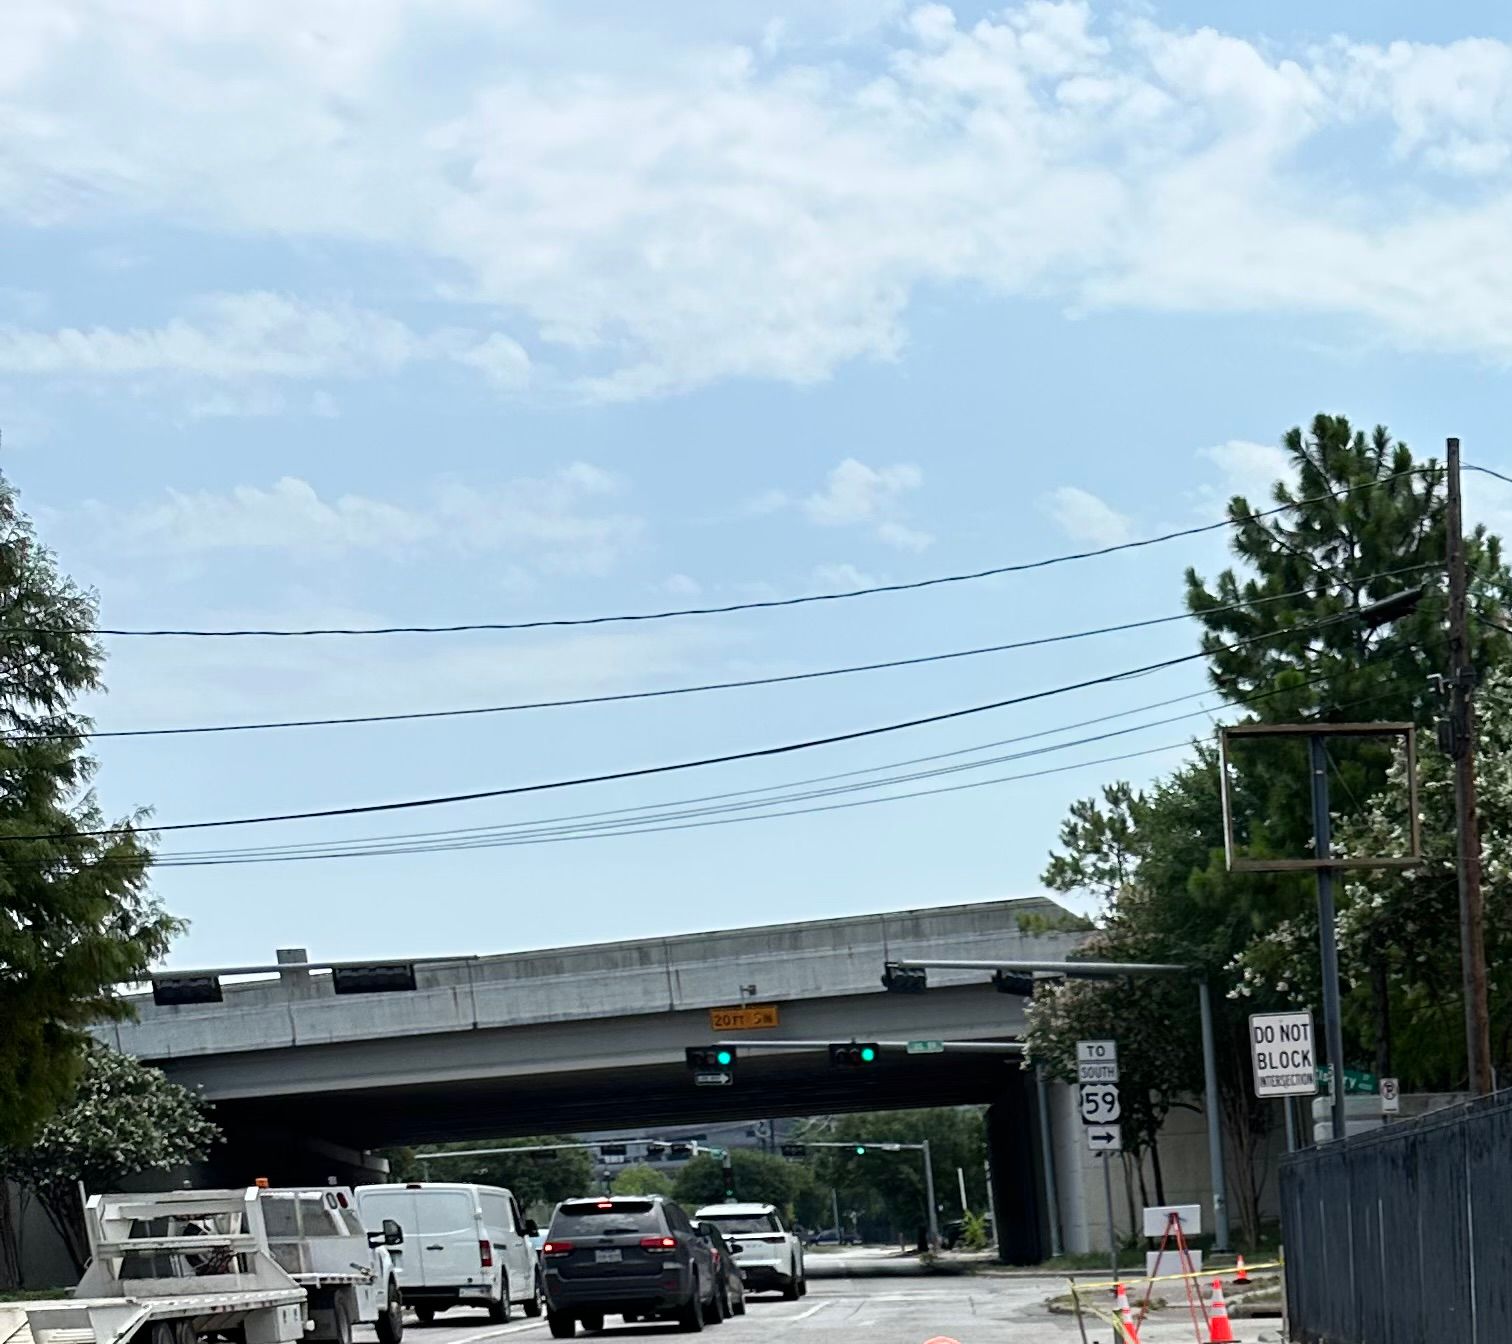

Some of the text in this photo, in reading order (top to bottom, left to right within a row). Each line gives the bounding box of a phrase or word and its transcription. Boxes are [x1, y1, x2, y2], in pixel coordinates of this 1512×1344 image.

[1254, 1024, 1309, 1044] DO NOT
[1086, 1045, 1106, 1057] TO
[1258, 1050, 1312, 1070] BLOCK
[1081, 1067, 1115, 1079] SOUTH
[1086, 1092, 1115, 1114] 59
